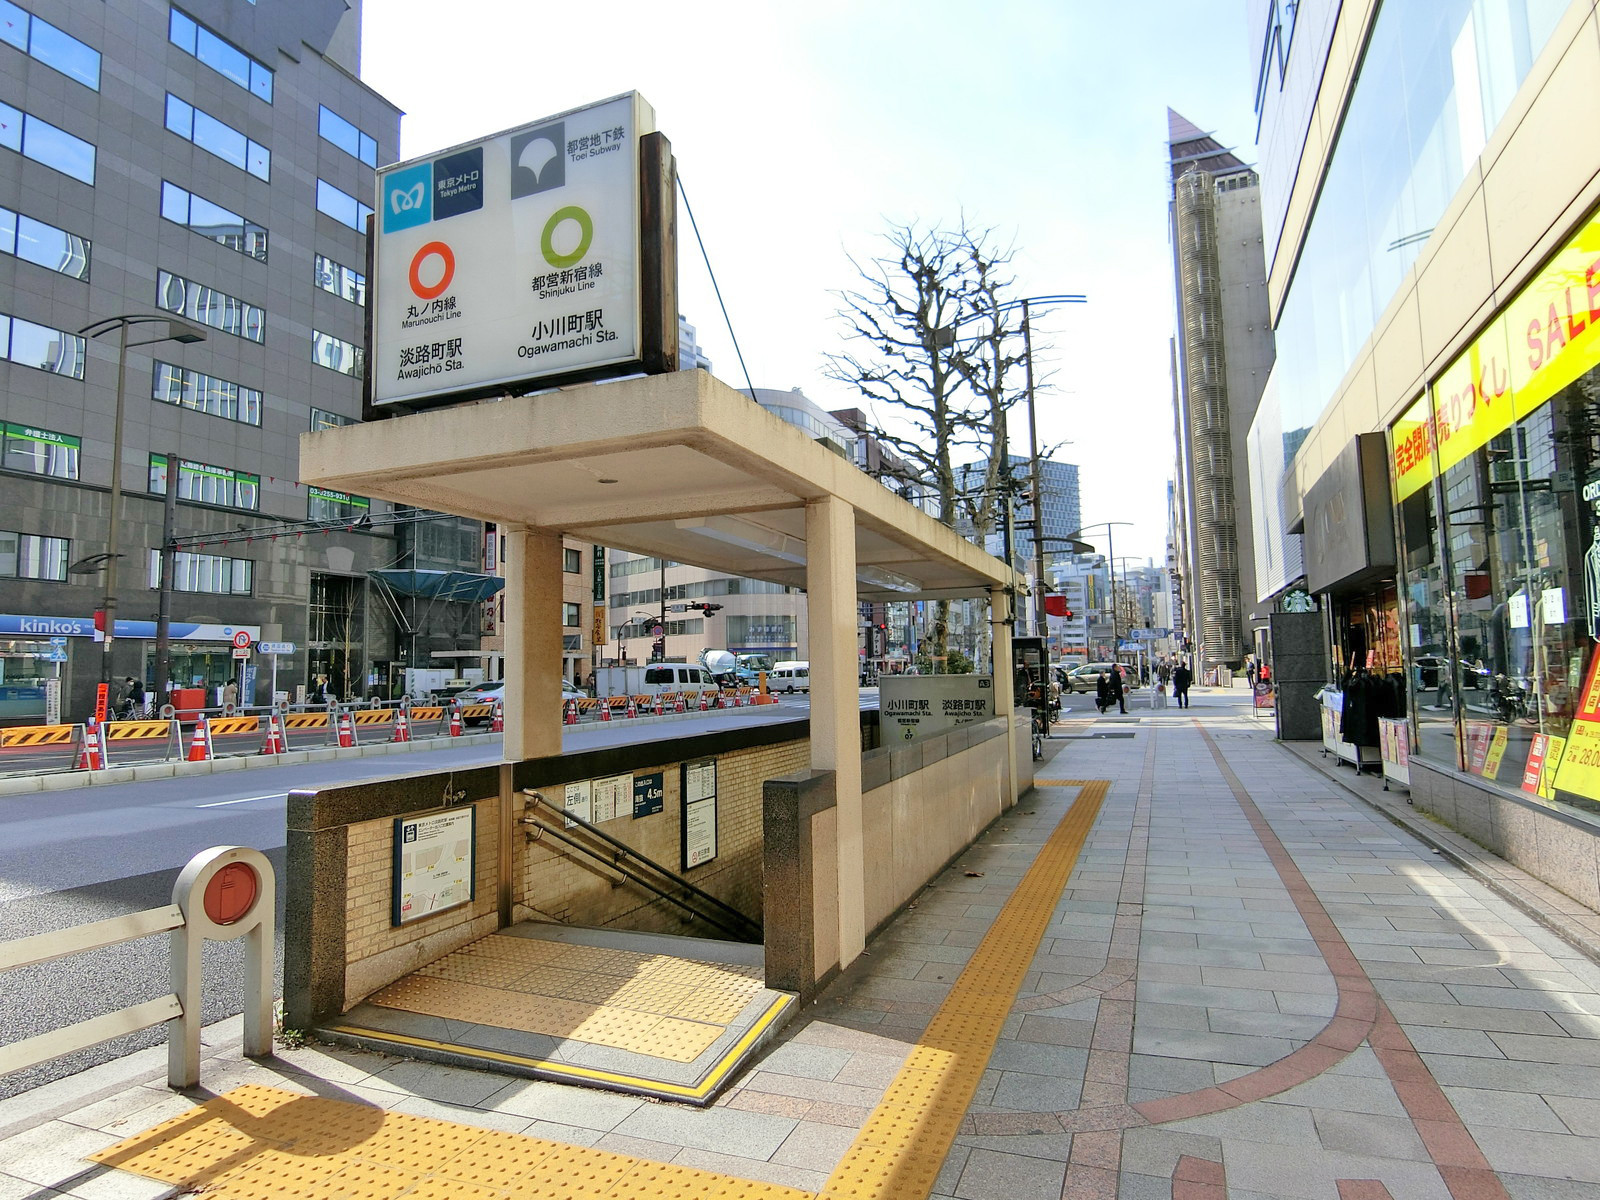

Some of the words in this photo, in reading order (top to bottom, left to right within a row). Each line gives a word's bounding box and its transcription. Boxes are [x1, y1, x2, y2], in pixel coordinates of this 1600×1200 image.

[566, 125, 625, 155] 都営地下鉄
[571, 151, 590, 162] Toei
[591, 142, 621, 160] Subway
[437, 170, 479, 191] 東京メトロ
[440, 187, 458, 199] Tokyo
[458, 183, 477, 194] Metro
[531, 262, 603, 293] 都営新宿線
[539, 284, 576, 300] Shinjuku
[577, 279, 596, 292] Line
[406, 296, 457, 319] 丸ノ内線
[1526, 258, 1600, 371] SALE
[402, 312, 445, 329] Marunouchi
[445, 309, 462, 322] Line
[531, 309, 604, 341] 小川町駅
[399, 337, 463, 368] 淡路町駅
[517, 333, 593, 359] Ogawamachi
[596, 330, 619, 344] Sta.
[397, 362, 443, 381] Awajichō
[445, 360, 465, 372] Sta.
[20, 618, 82, 634] kinko's
[979, 680, 991, 688] A3
[887, 699, 929, 710] 小川町駅
[942, 699, 986, 710] 淡路町駅
